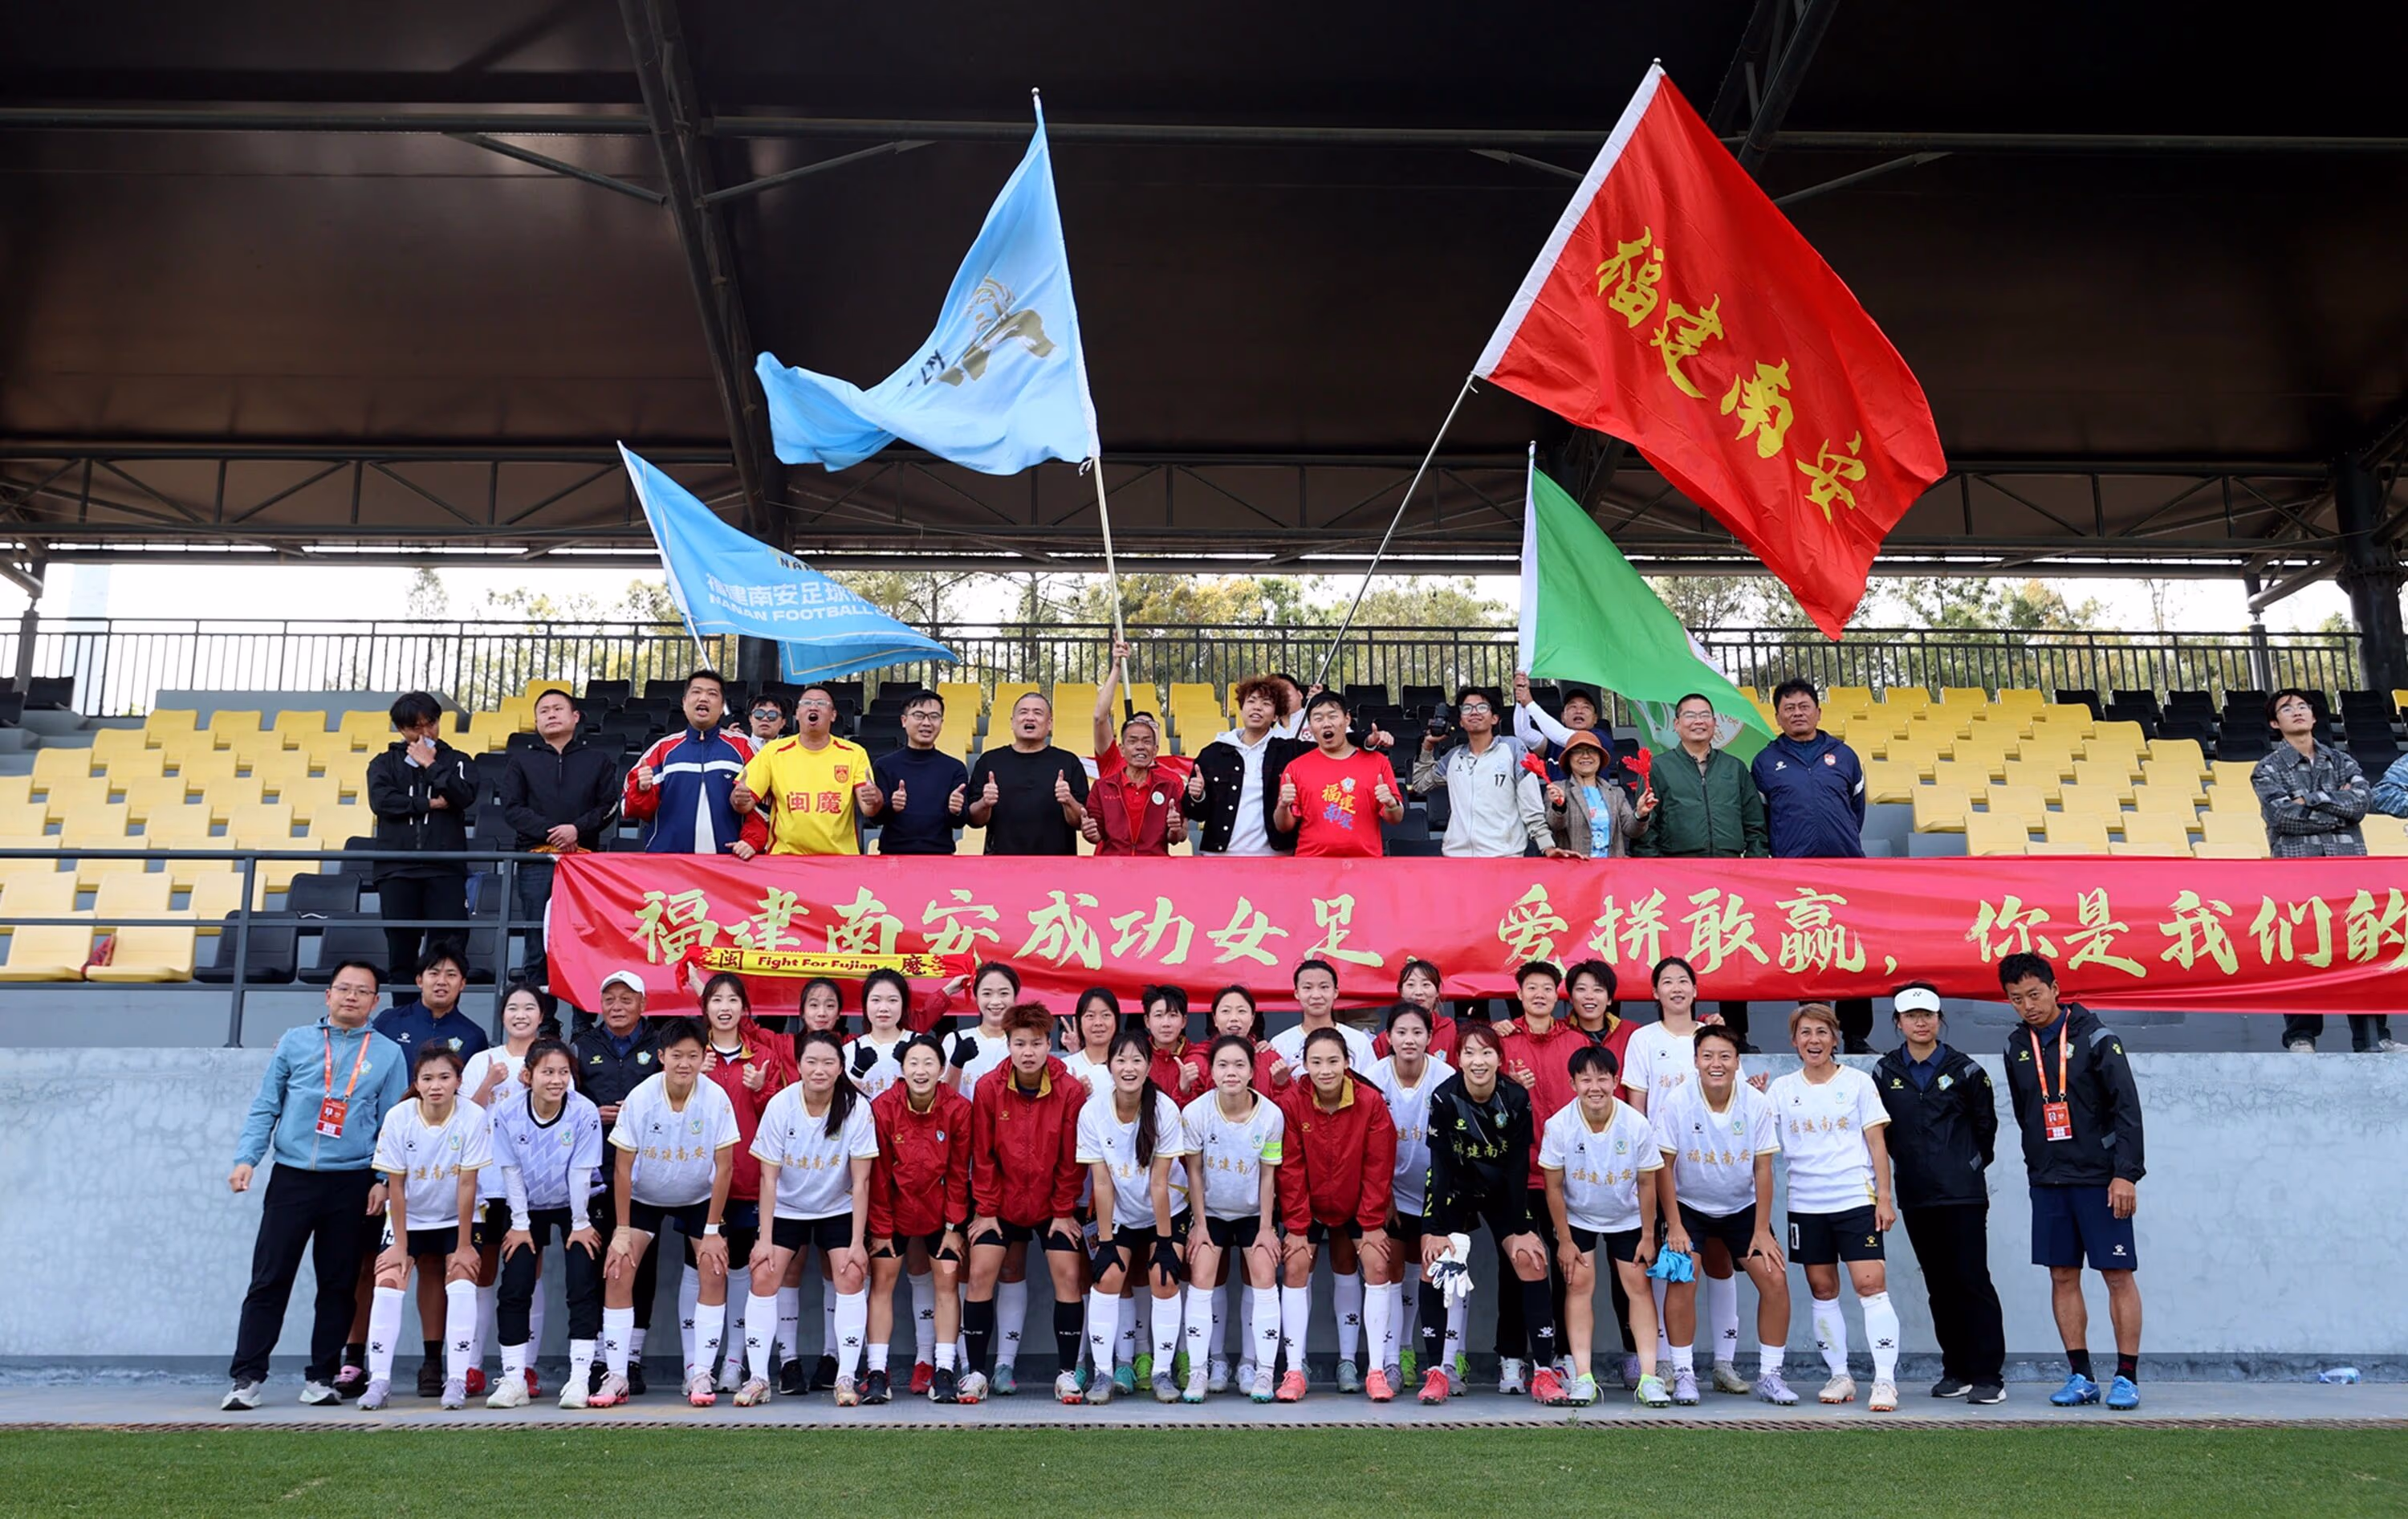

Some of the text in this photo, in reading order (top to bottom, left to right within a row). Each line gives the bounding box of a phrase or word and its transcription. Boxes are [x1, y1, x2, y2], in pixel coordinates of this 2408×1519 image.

[1596, 226, 1867, 523] 福建南安
[709, 593, 767, 621] NANAN
[772, 605, 873, 621] FOOTBALL
[1495, 773, 1506, 787] 17
[787, 791, 841, 813] 闽魔
[628, 886, 1385, 971] 福建南安成功女足
[1965, 886, 2408, 978] 你是我们的
[718, 949, 927, 975] 闽 Fight For Fujian 魔
[1790, 1115, 1849, 1134] 福建南安
[643, 1146, 706, 1163] 福建南安
[1686, 1149, 1751, 1166] 福建南安
[1572, 1168, 1633, 1186] 福建南安
